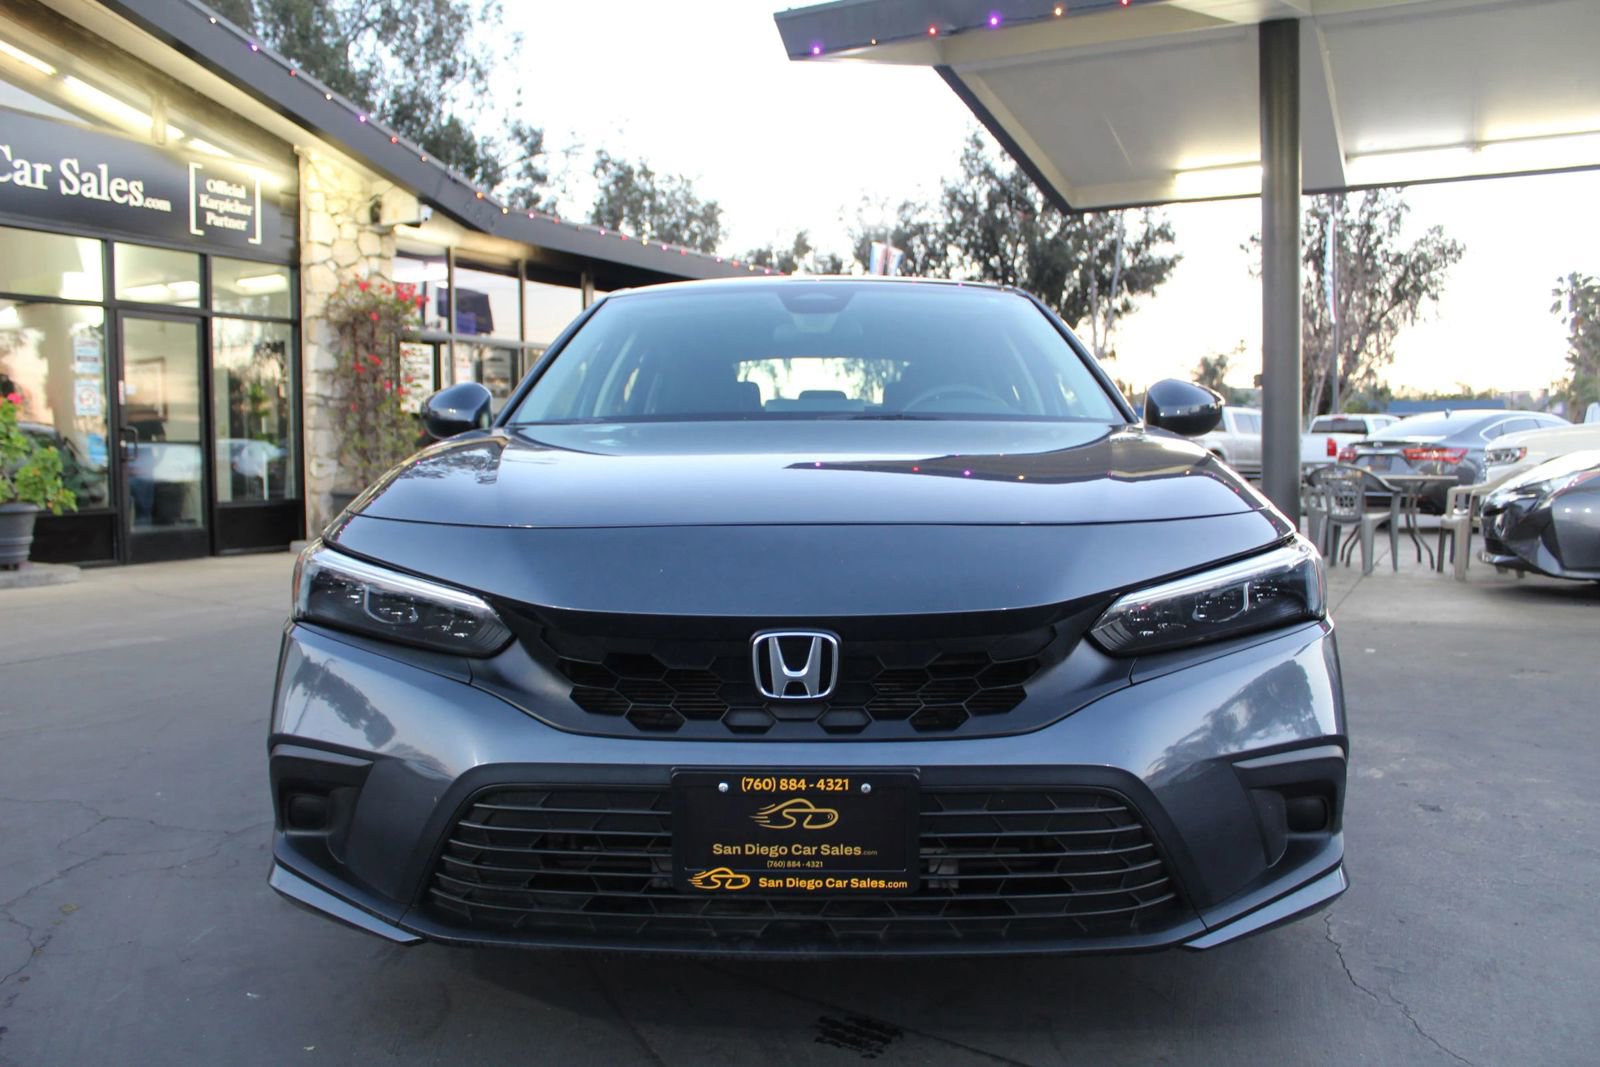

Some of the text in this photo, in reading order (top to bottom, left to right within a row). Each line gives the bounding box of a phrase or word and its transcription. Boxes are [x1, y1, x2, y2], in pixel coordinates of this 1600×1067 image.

[205, 179, 247, 200] Official
[205, 211, 248, 231] Partner
[741, 777, 776, 792] (760)
[779, 778, 806, 791] 884
[816, 778, 849, 791] 4321
[712, 843, 741, 855] San
[744, 843, 788, 857] Diego
[791, 843, 818, 856] Car
[766, 860, 785, 868] (760)
[806, 860, 823, 868] 4321
[758, 877, 908, 890] San Diego Car Sales.com
